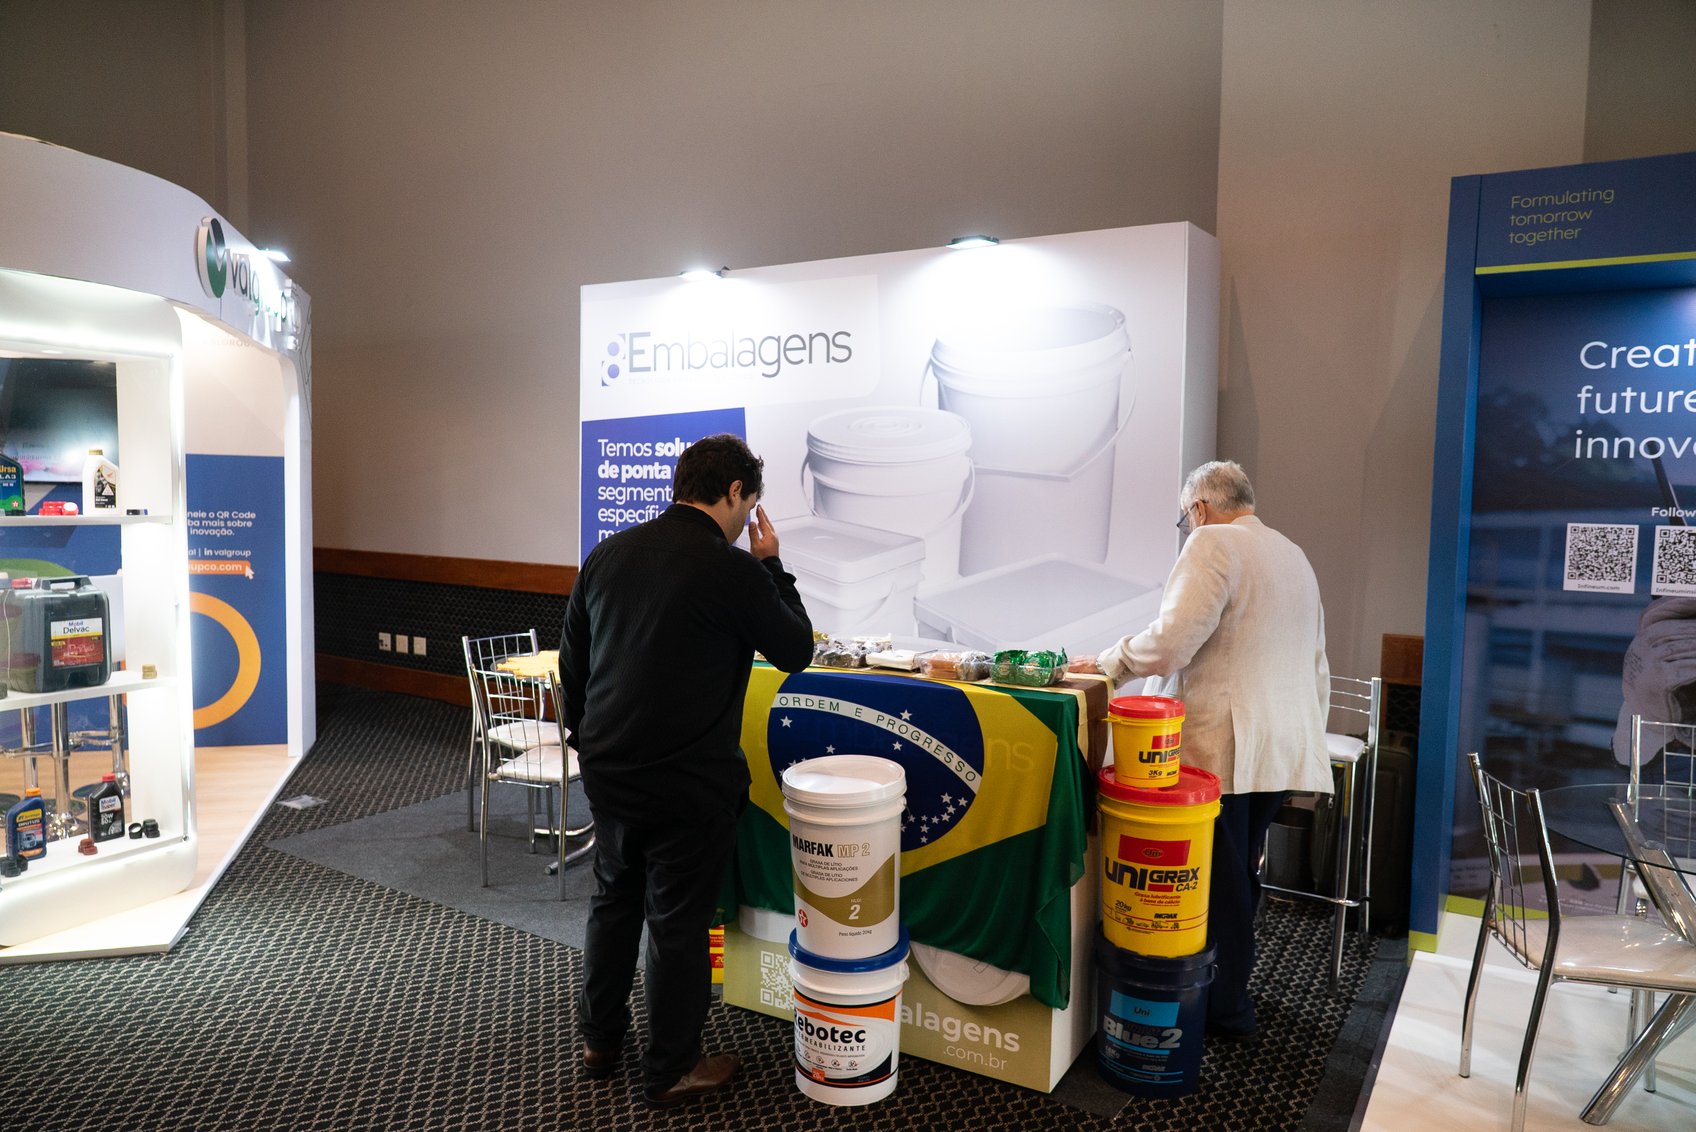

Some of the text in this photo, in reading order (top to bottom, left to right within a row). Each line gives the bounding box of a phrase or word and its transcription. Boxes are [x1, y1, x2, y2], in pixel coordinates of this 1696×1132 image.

[1511, 188, 1615, 209] Formulating
[1510, 210, 1593, 226] tomorrow
[1509, 227, 1582, 246] together
[629, 331, 852, 378] Embalagens
[1580, 339, 1696, 369] Creat
[1577, 385, 1696, 413] future
[597, 437, 695, 457] Temos solu
[1575, 429, 1696, 459] innov
[597, 460, 672, 483] de ponta
[597, 485, 674, 505] segment
[216, 510, 230, 519] QR
[231, 511, 256, 519] Code
[597, 505, 666, 527] específi
[1651, 506, 1696, 518] Follow
[190, 527, 235, 537] inovação.
[202, 519, 225, 527] mais
[214, 548, 252, 558] valgroup
[63, 626, 90, 635] Delvac
[779, 696, 977, 783] ORDEM E PROGRESSO
[792, 833, 871, 858] MARFAK MP 2
[1175, 881, 1198, 892] CA-2
[848, 904, 861, 920] 2
[1134, 1006, 1152, 1017] Uni
[901, 1002, 1020, 1053] alagens
[942, 1044, 1008, 1070] .com.br
